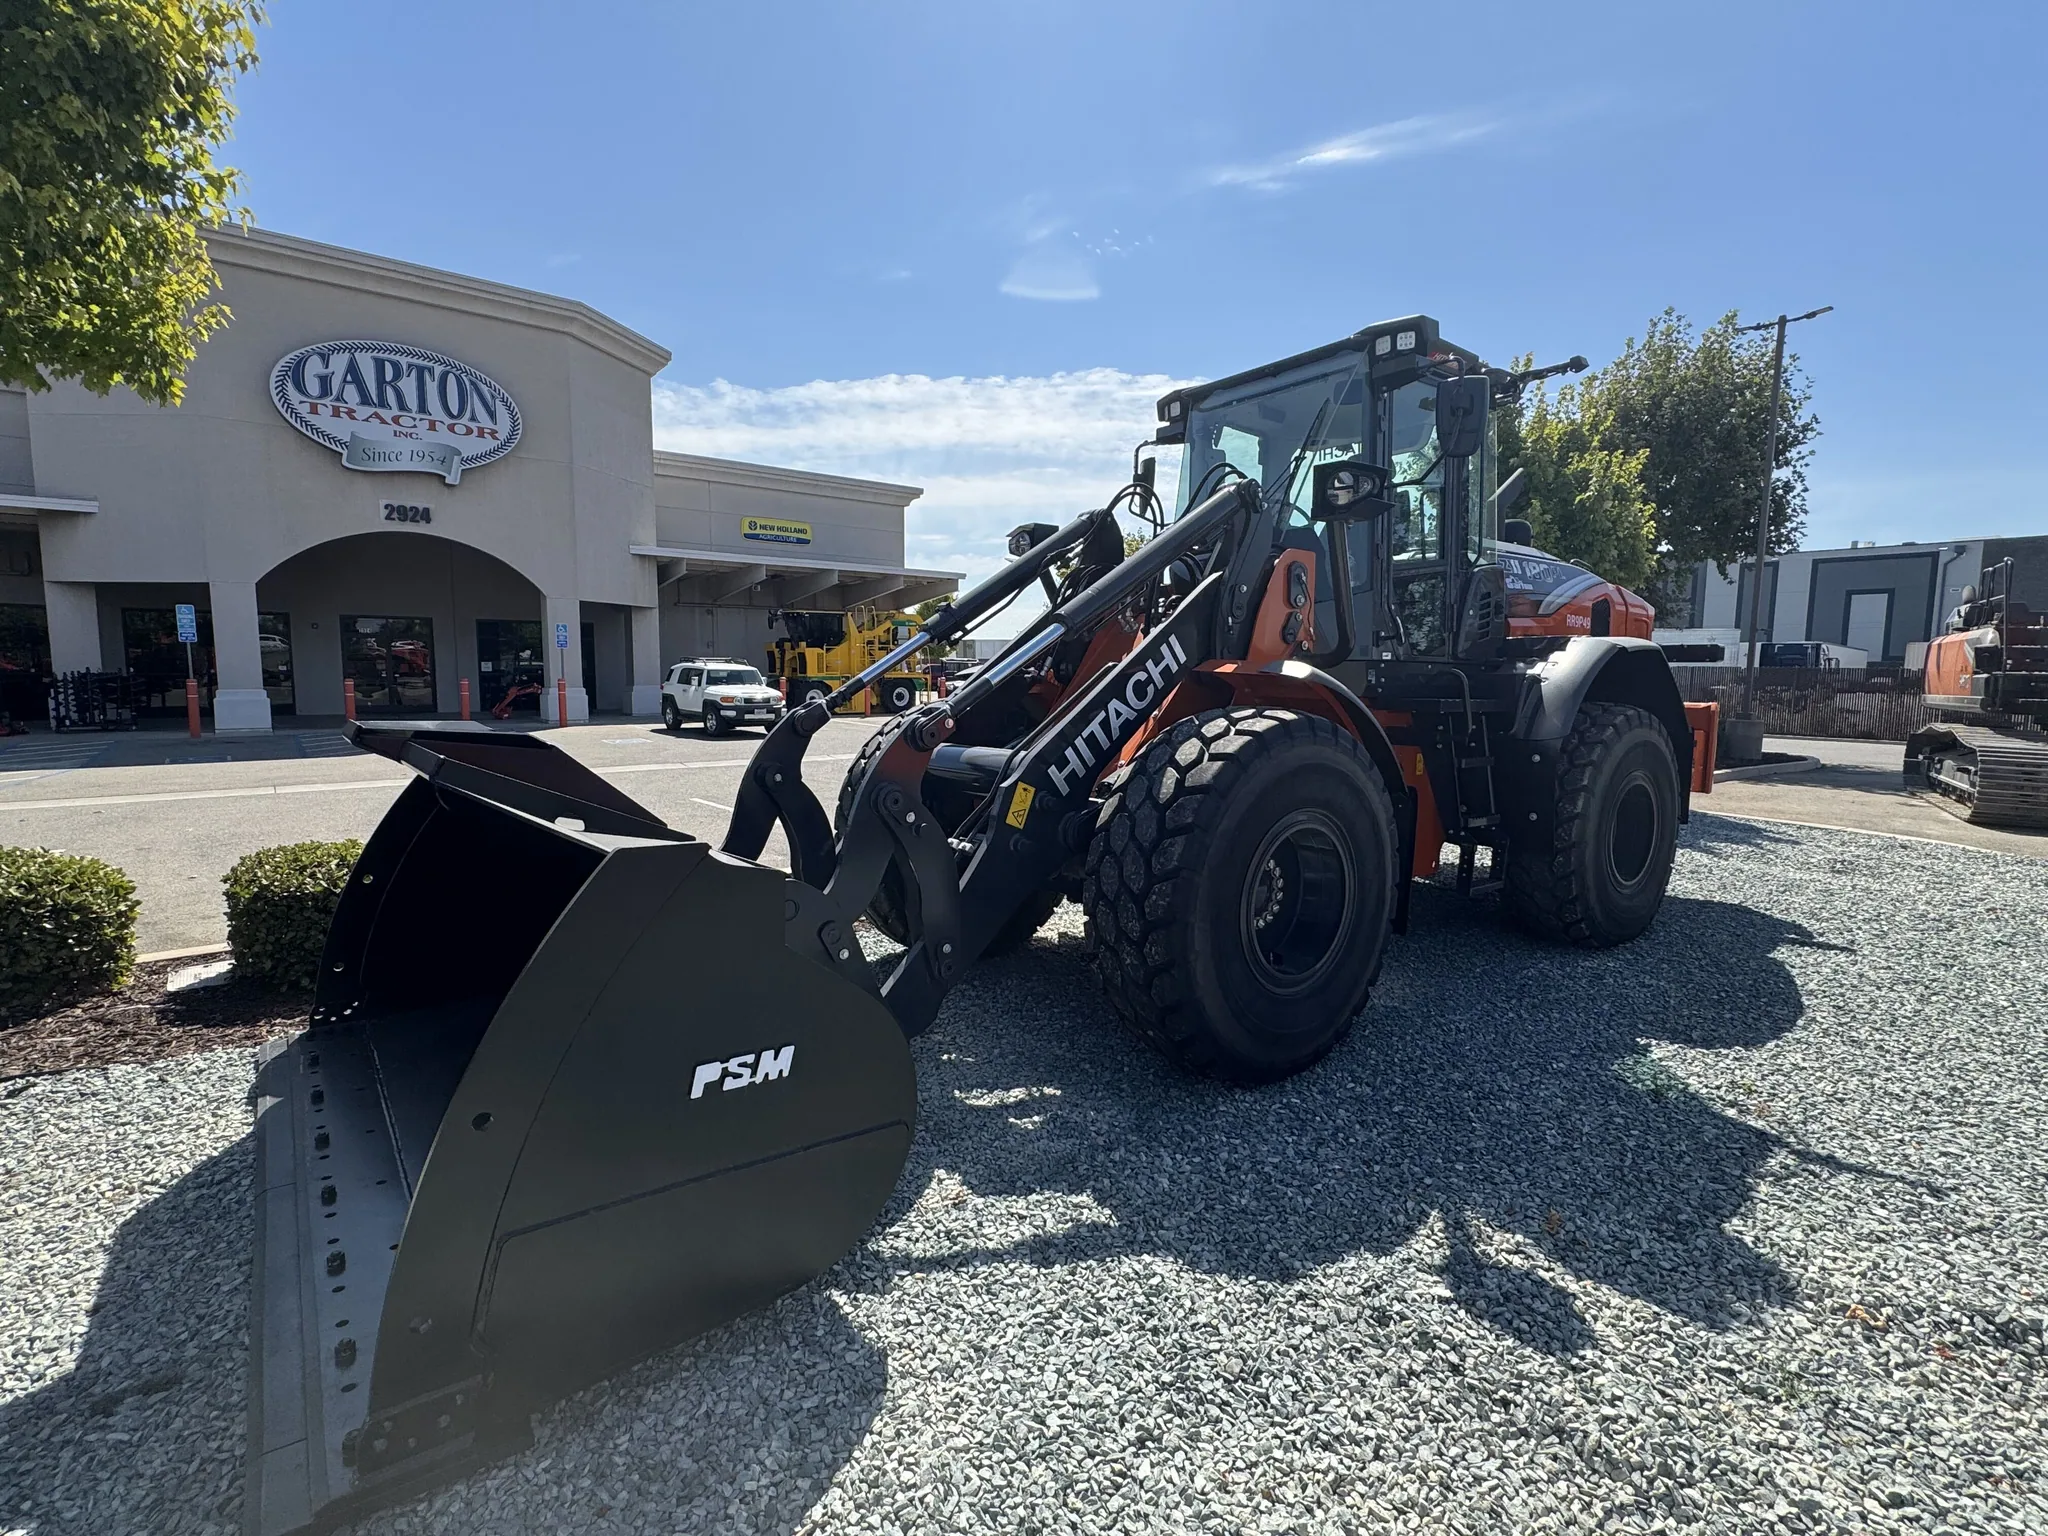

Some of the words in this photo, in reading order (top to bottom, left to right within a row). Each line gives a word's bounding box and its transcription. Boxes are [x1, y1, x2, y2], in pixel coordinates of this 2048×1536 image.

[291, 351, 501, 425] GARTON
[299, 401, 501, 440] TRACTOR
[393, 430, 423, 440] INC.
[361, 447, 402, 463] Since
[409, 449, 447, 466] 1954
[384, 503, 431, 524] 2924
[759, 534, 797, 542] AGRICULTURE
[777, 525, 808, 535] HOLLAND
[1047, 634, 1187, 796] HITACHI
[690, 1045, 795, 1099] PSM
